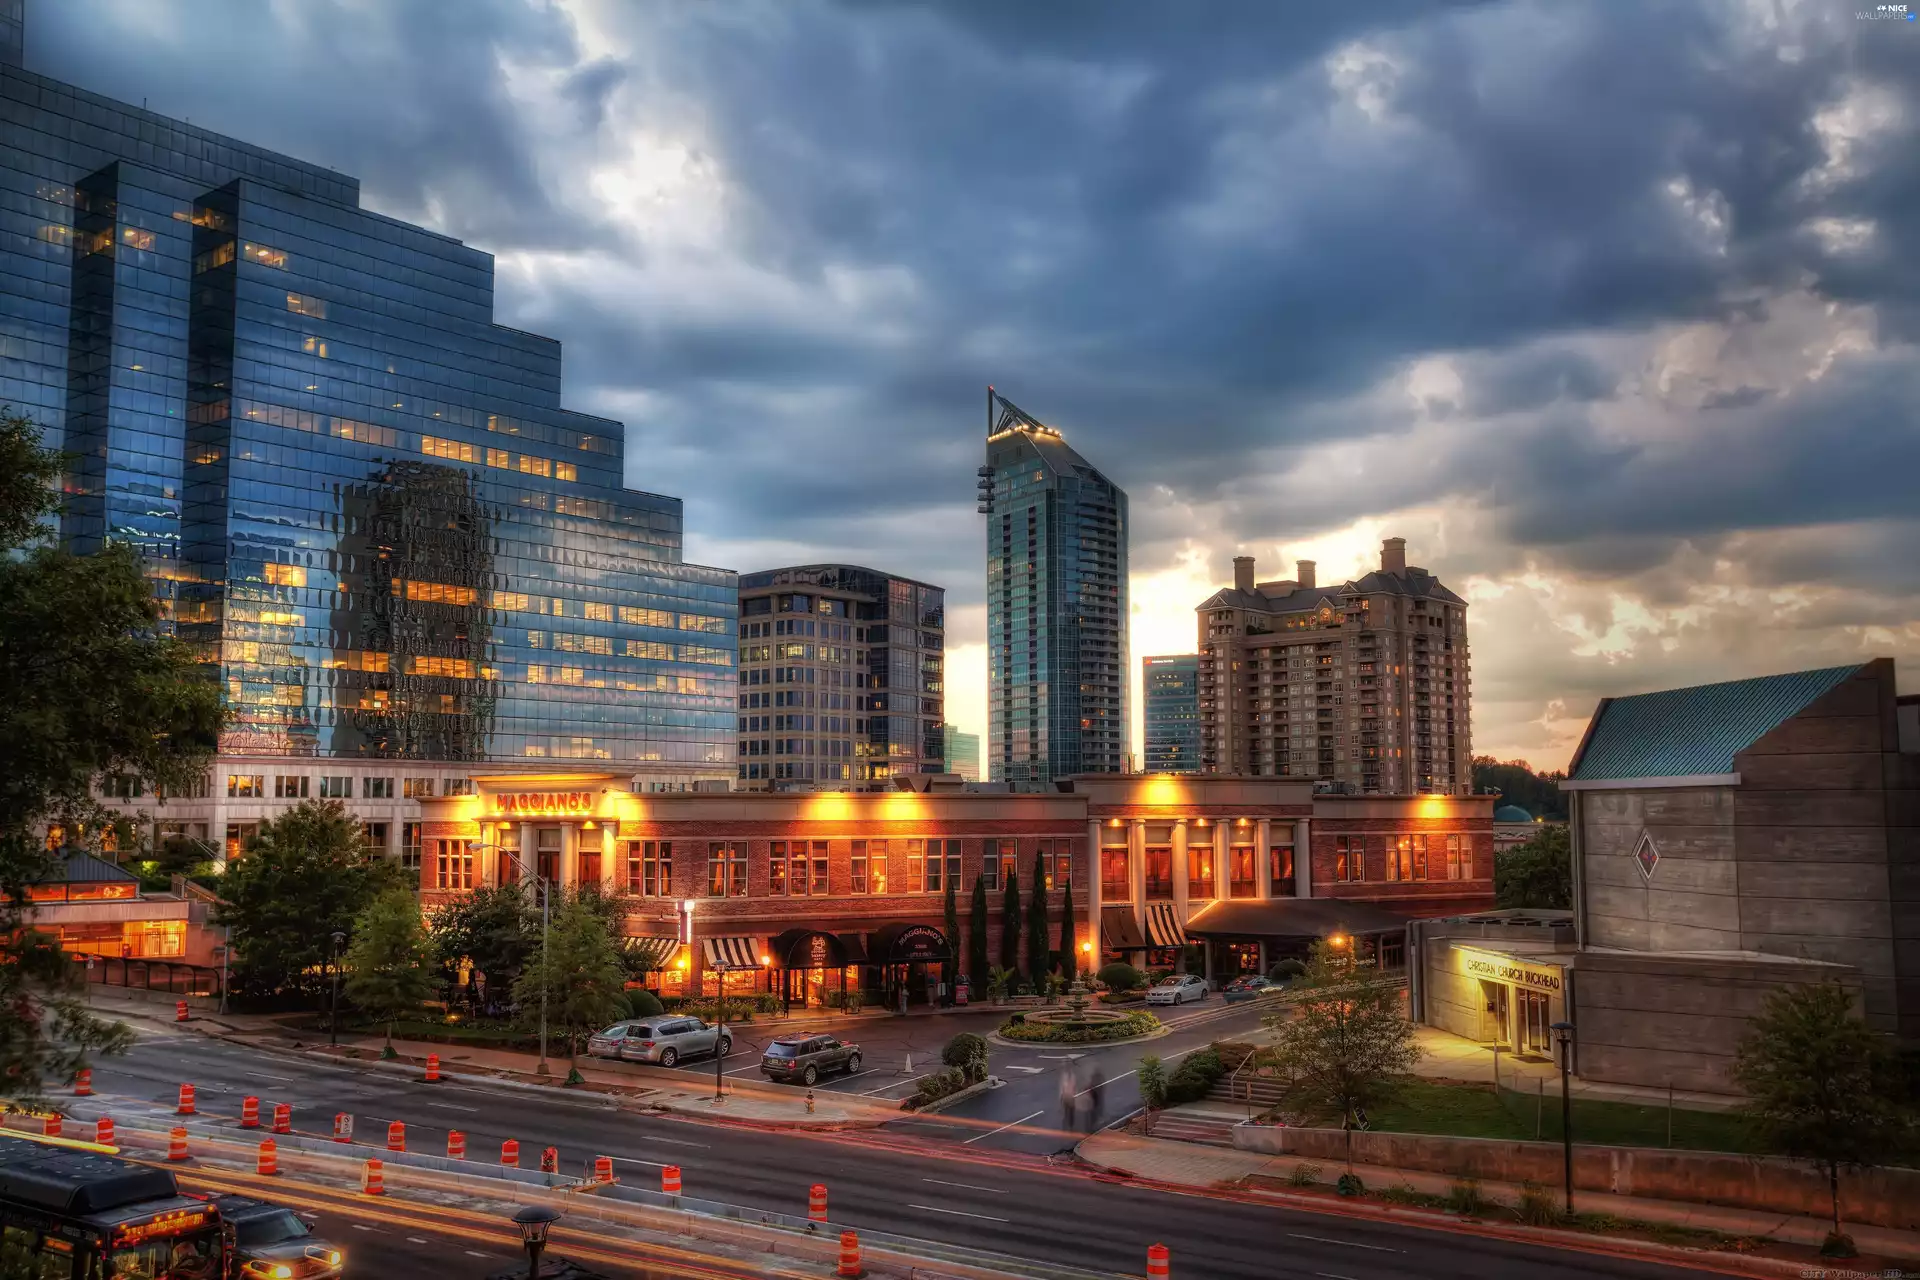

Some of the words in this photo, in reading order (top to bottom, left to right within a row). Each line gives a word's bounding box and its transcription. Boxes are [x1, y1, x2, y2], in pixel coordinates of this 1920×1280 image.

[496, 792, 592, 812] MAGGIANO'S
[898, 927, 944, 946] MAGGIANO'S
[1467, 959, 1496, 976] CHRISTIAN
[1498, 966, 1523, 981] CHURCH
[1524, 971, 1560, 989] BUCKHEAD
